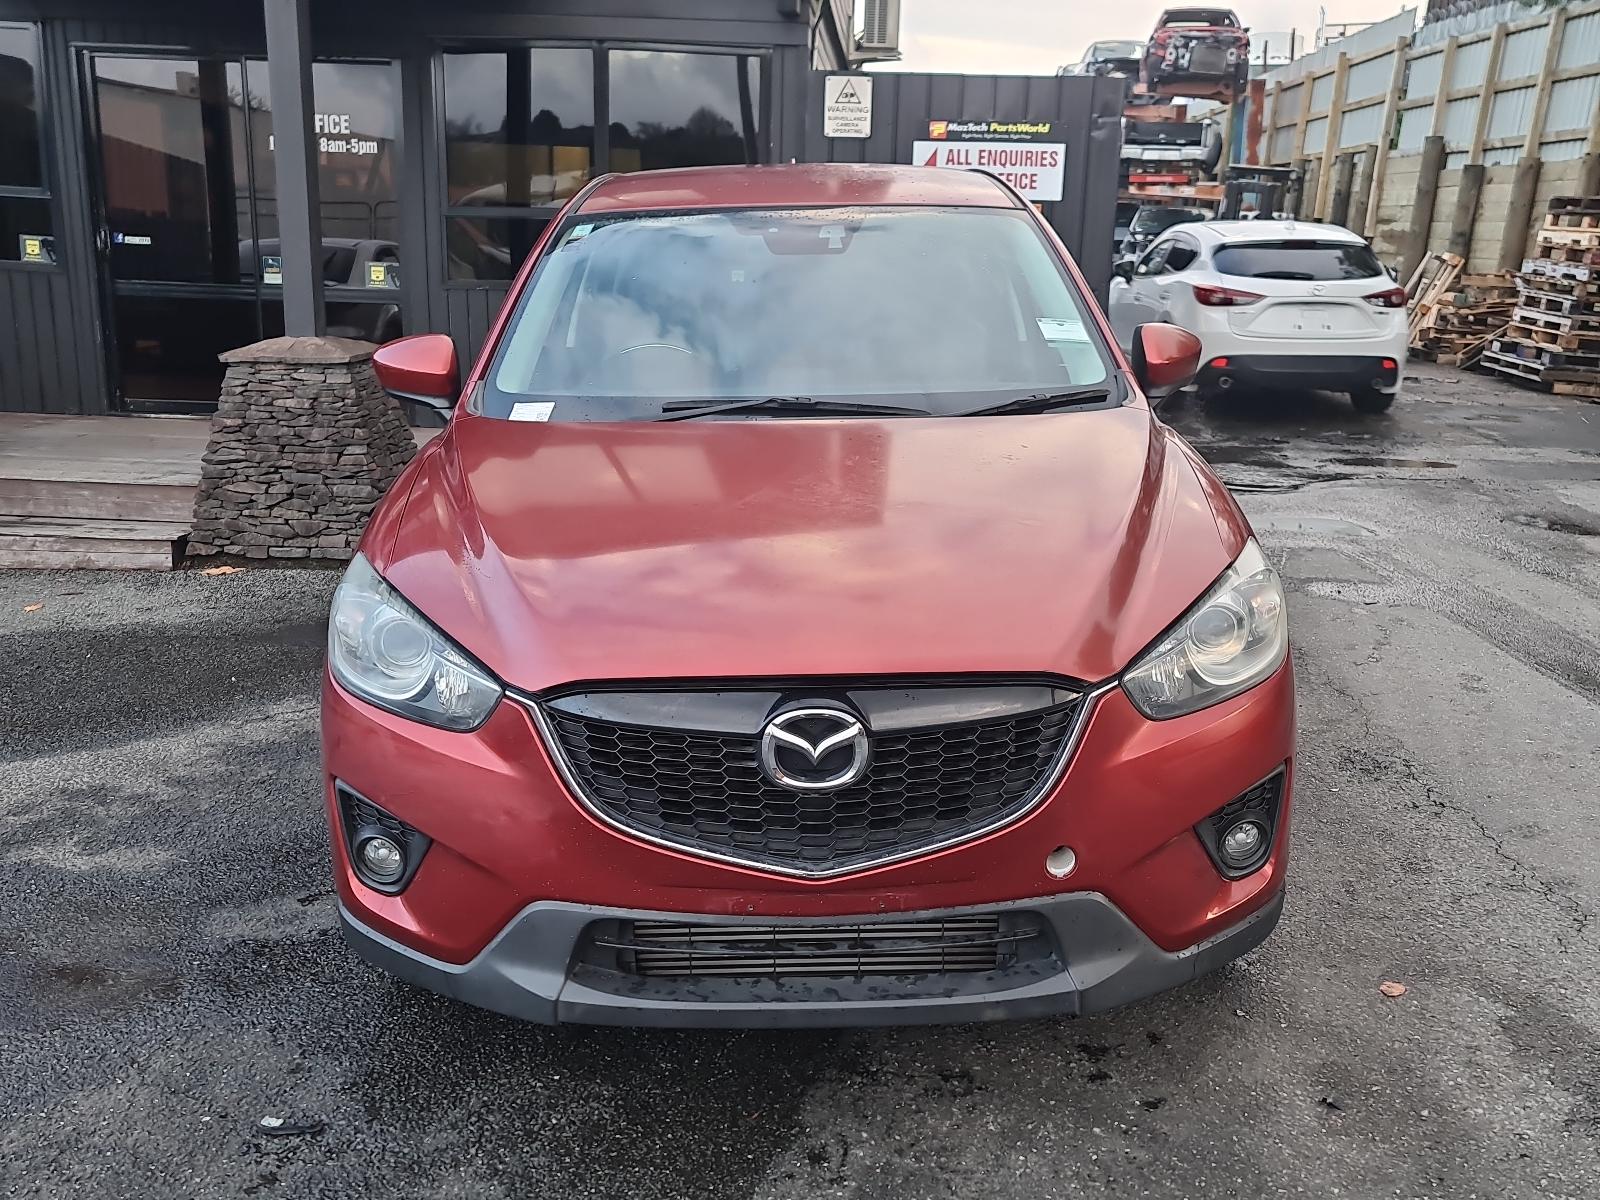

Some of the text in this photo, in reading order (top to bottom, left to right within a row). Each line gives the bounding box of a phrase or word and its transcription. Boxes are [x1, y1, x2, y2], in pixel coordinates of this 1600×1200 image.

[827, 106, 869, 114] WARNING
[314, 114, 351, 134] FICE
[947, 122, 1051, 133] MazTech PartsWorld
[319, 137, 378, 155] 8am-5pm
[945, 149, 1059, 168] ALL ENQUIRIES
[998, 173, 1038, 190] FICE
